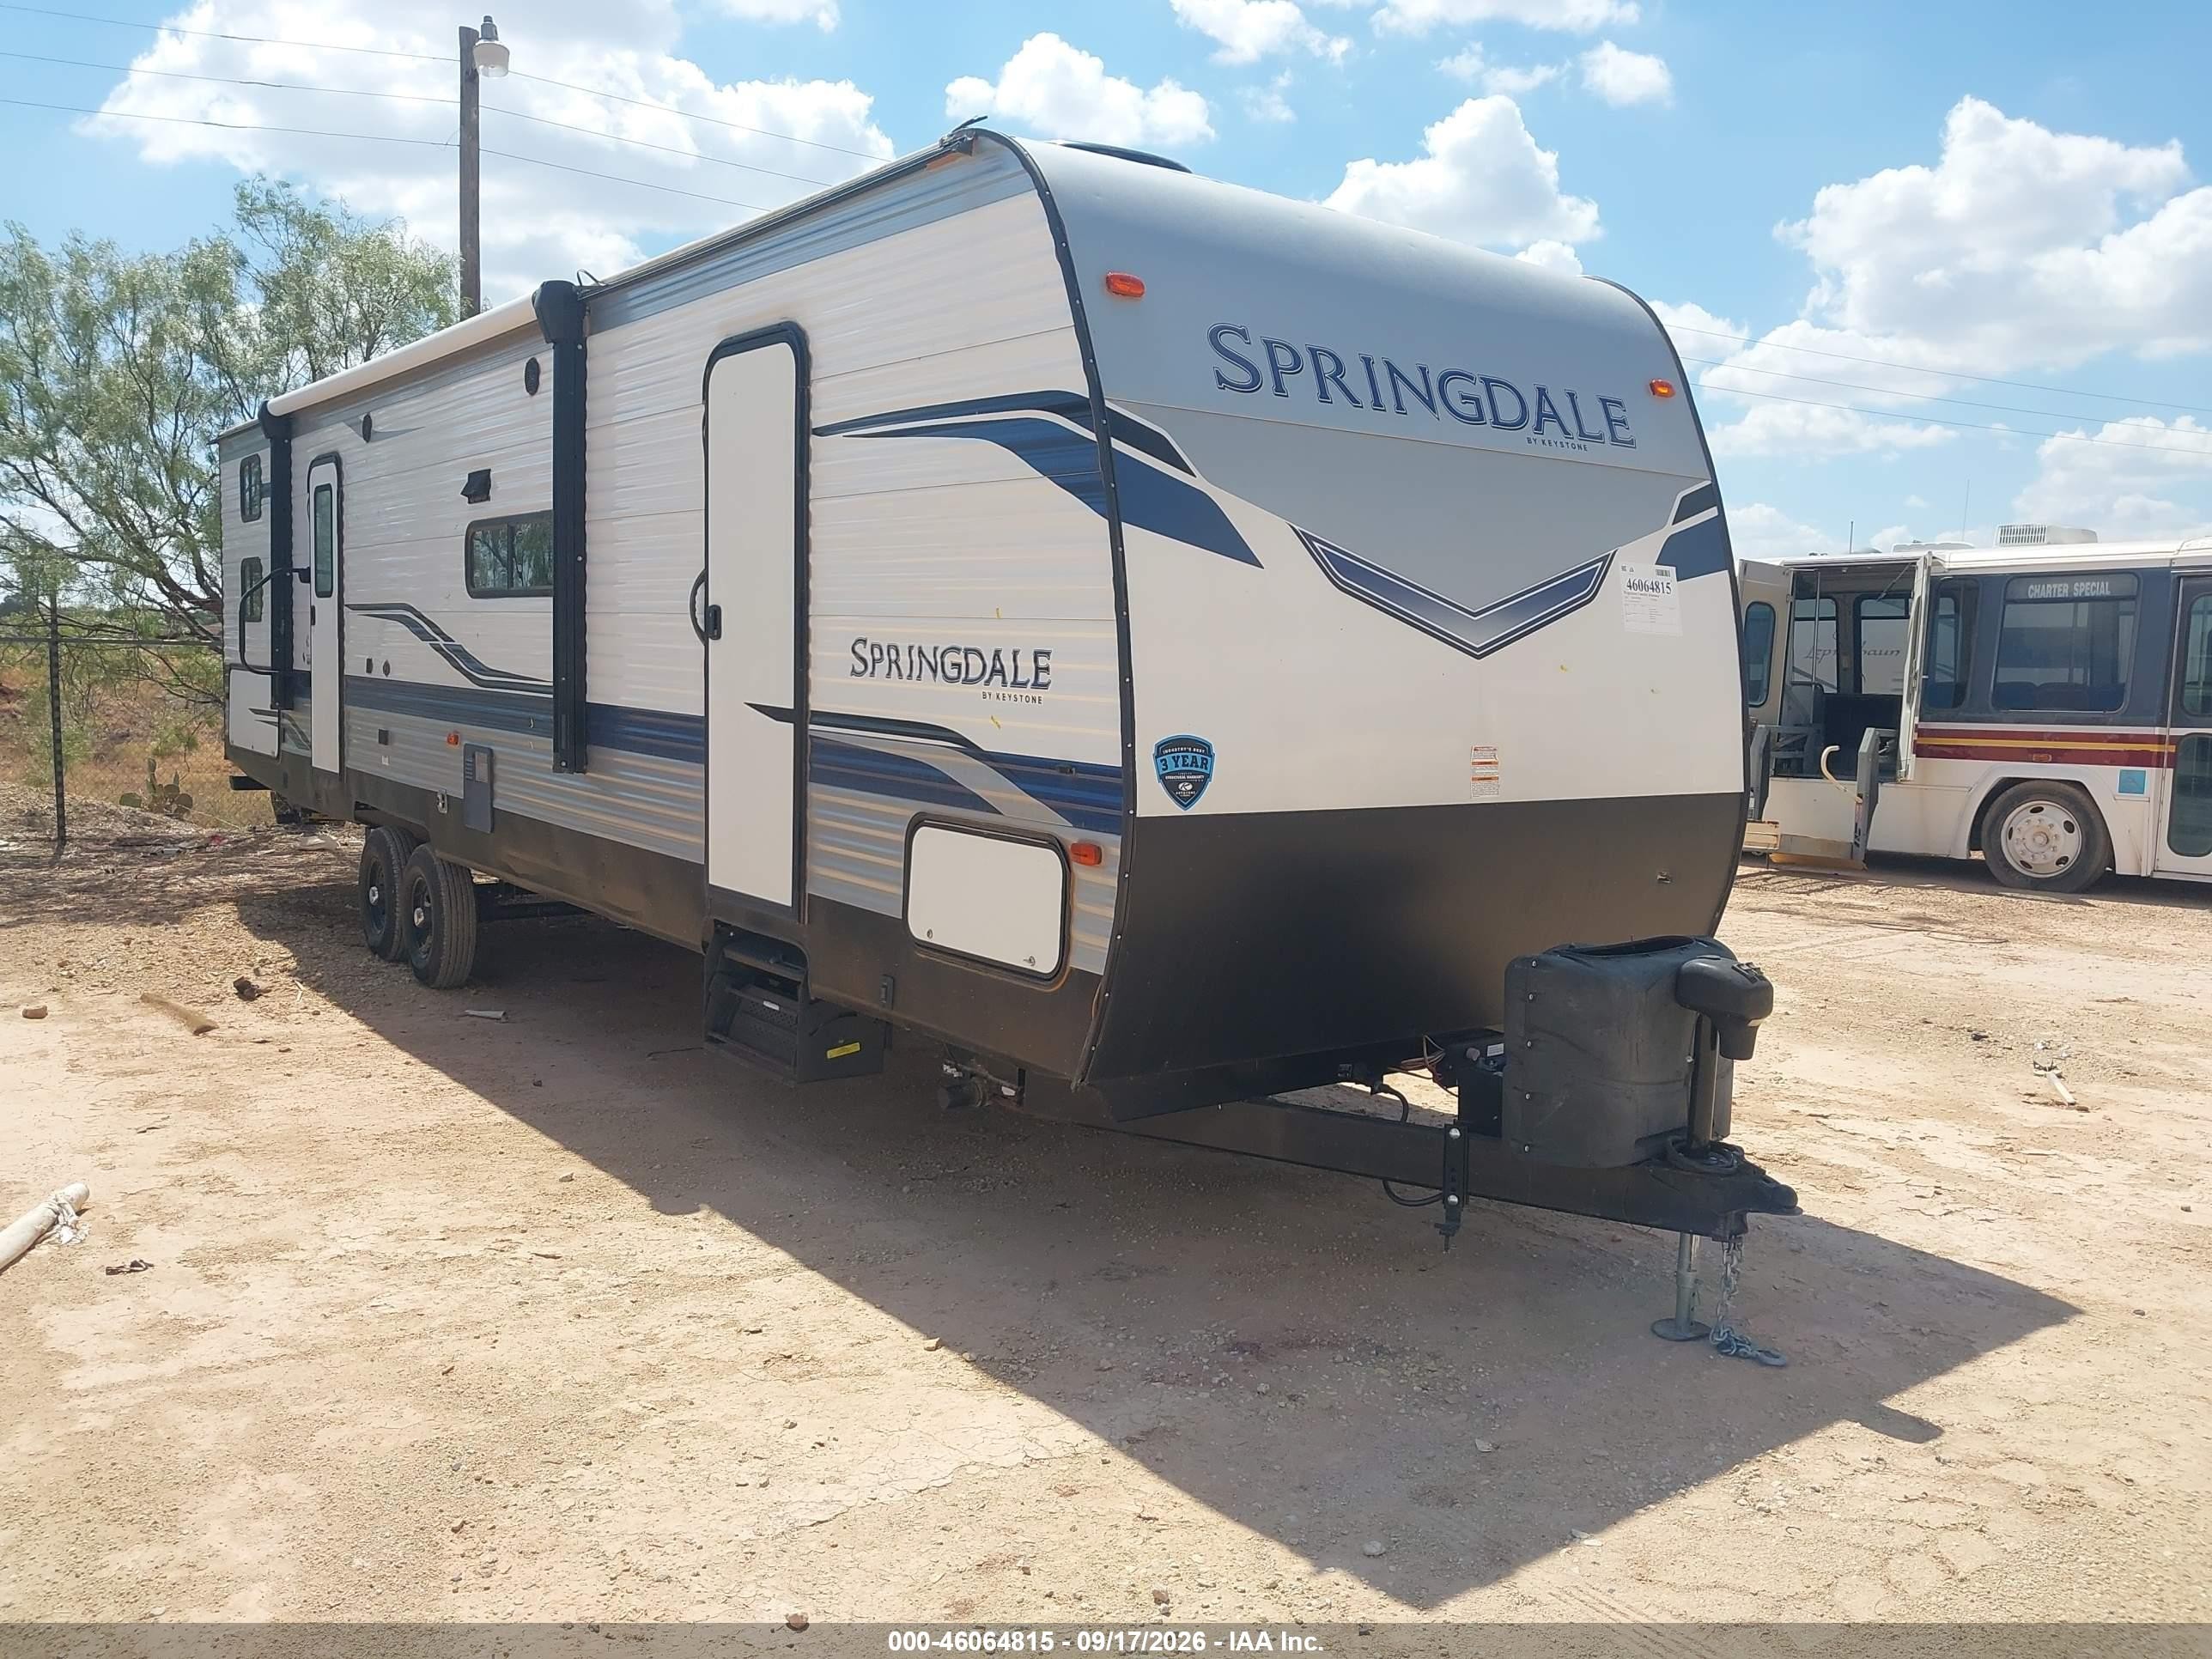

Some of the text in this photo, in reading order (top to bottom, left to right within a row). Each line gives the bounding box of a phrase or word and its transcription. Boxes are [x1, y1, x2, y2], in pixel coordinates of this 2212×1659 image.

[1206, 322, 1637, 448] SPRINGDALE
[1526, 436, 1588, 452] BY KEYSTONE
[1626, 578, 1672, 595] 46064815
[2027, 581, 2112, 599] CHARTER SPECIAL
[850, 636, 1053, 690] SPRINGDALE
[981, 691, 1043, 705] BY KEYSTONE
[1159, 755, 1209, 771] 3 YEAR
